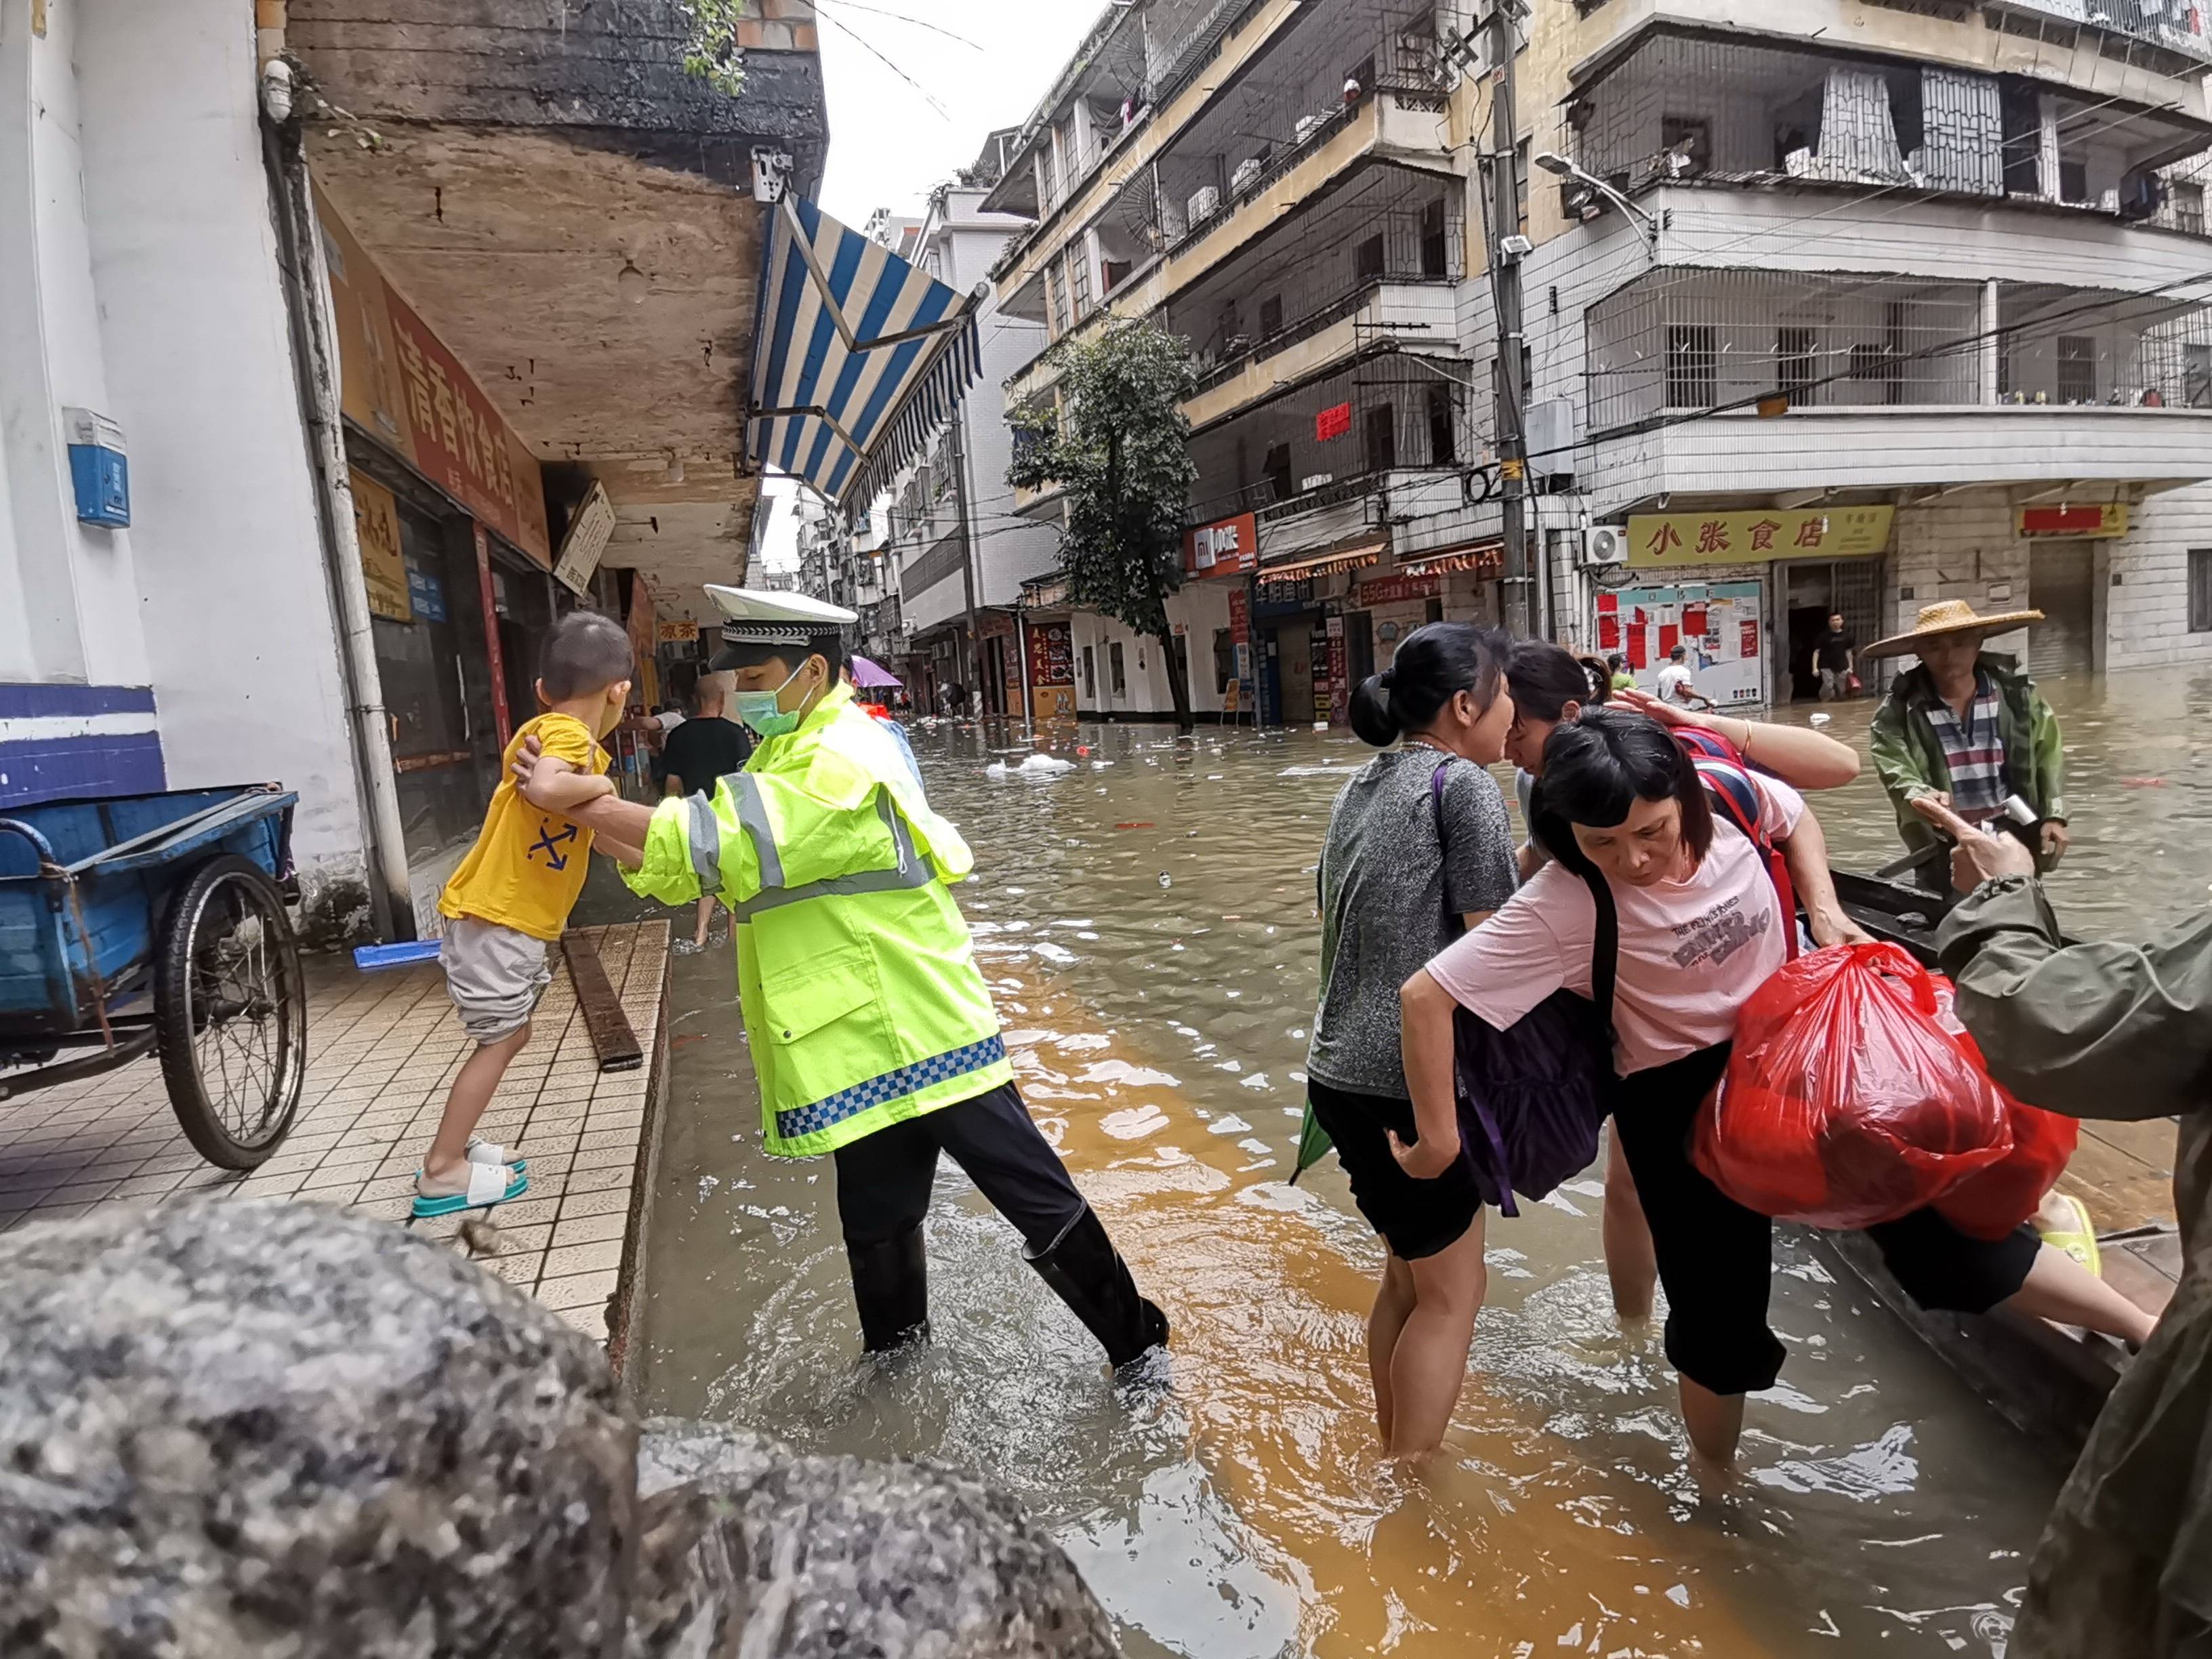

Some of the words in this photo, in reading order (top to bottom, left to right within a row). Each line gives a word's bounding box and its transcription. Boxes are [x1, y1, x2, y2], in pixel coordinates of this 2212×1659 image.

[394, 317, 514, 510] 清香饮食店
[1645, 516, 1826, 556] 小张食店
[659, 620, 697, 640] 凉茶
